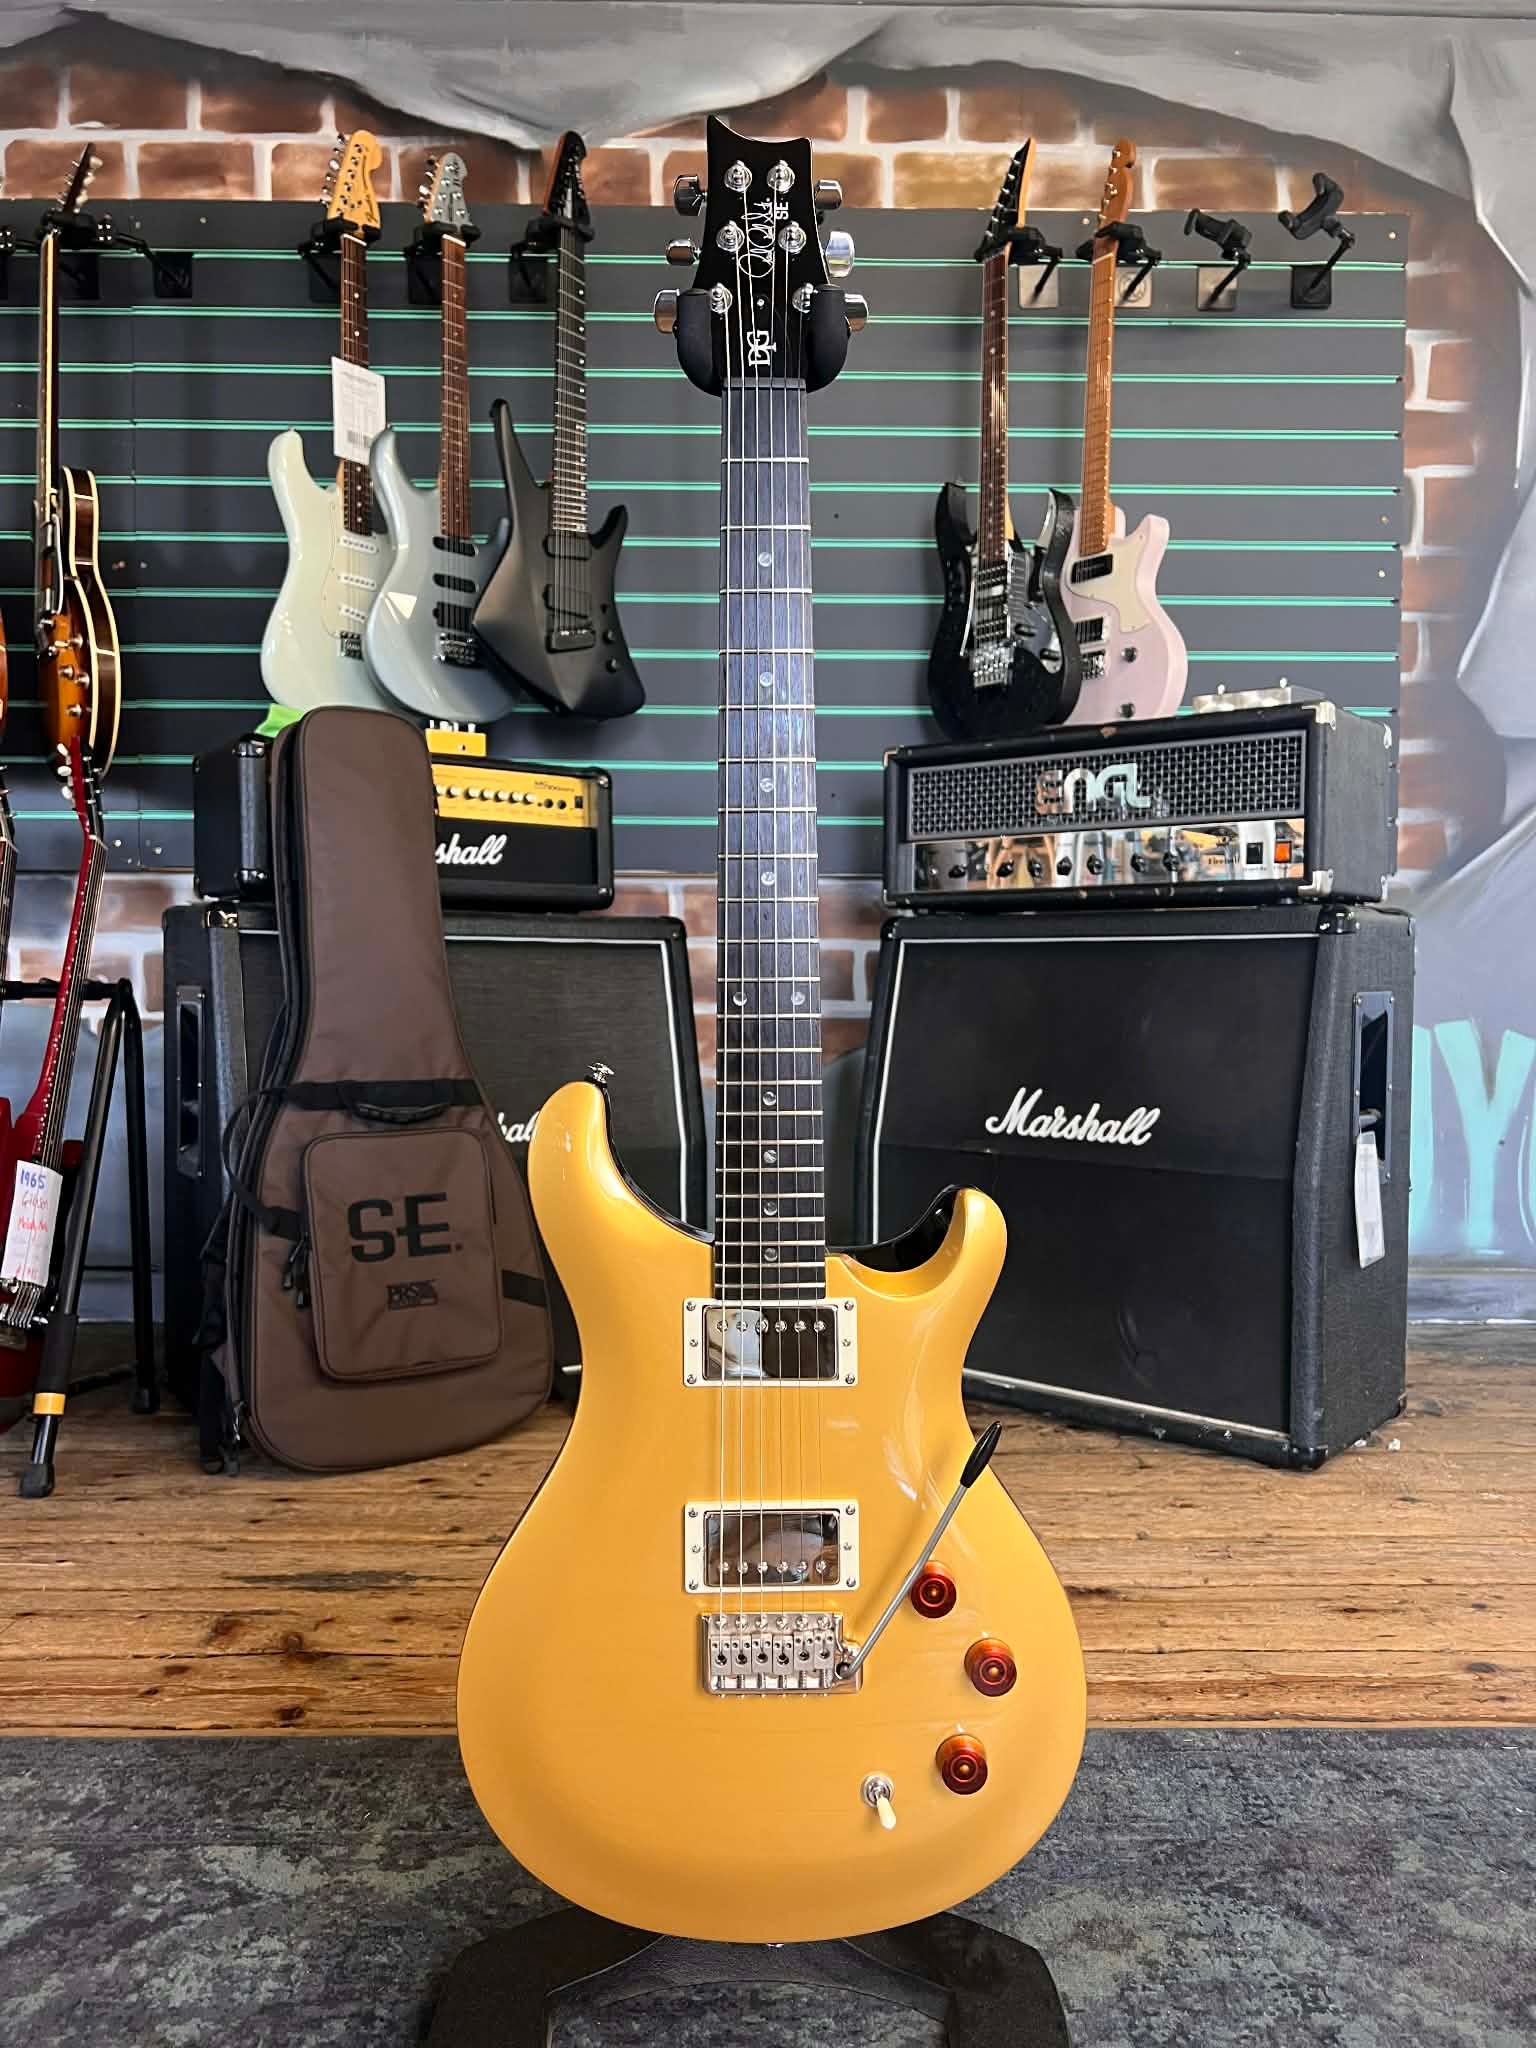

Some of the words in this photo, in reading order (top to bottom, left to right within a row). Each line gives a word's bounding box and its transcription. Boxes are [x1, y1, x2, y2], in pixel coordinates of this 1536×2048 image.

[776, 200, 790, 221] SE
[985, 1086, 1162, 1146] Marshall
[20, 1169, 47, 1190] 1965
